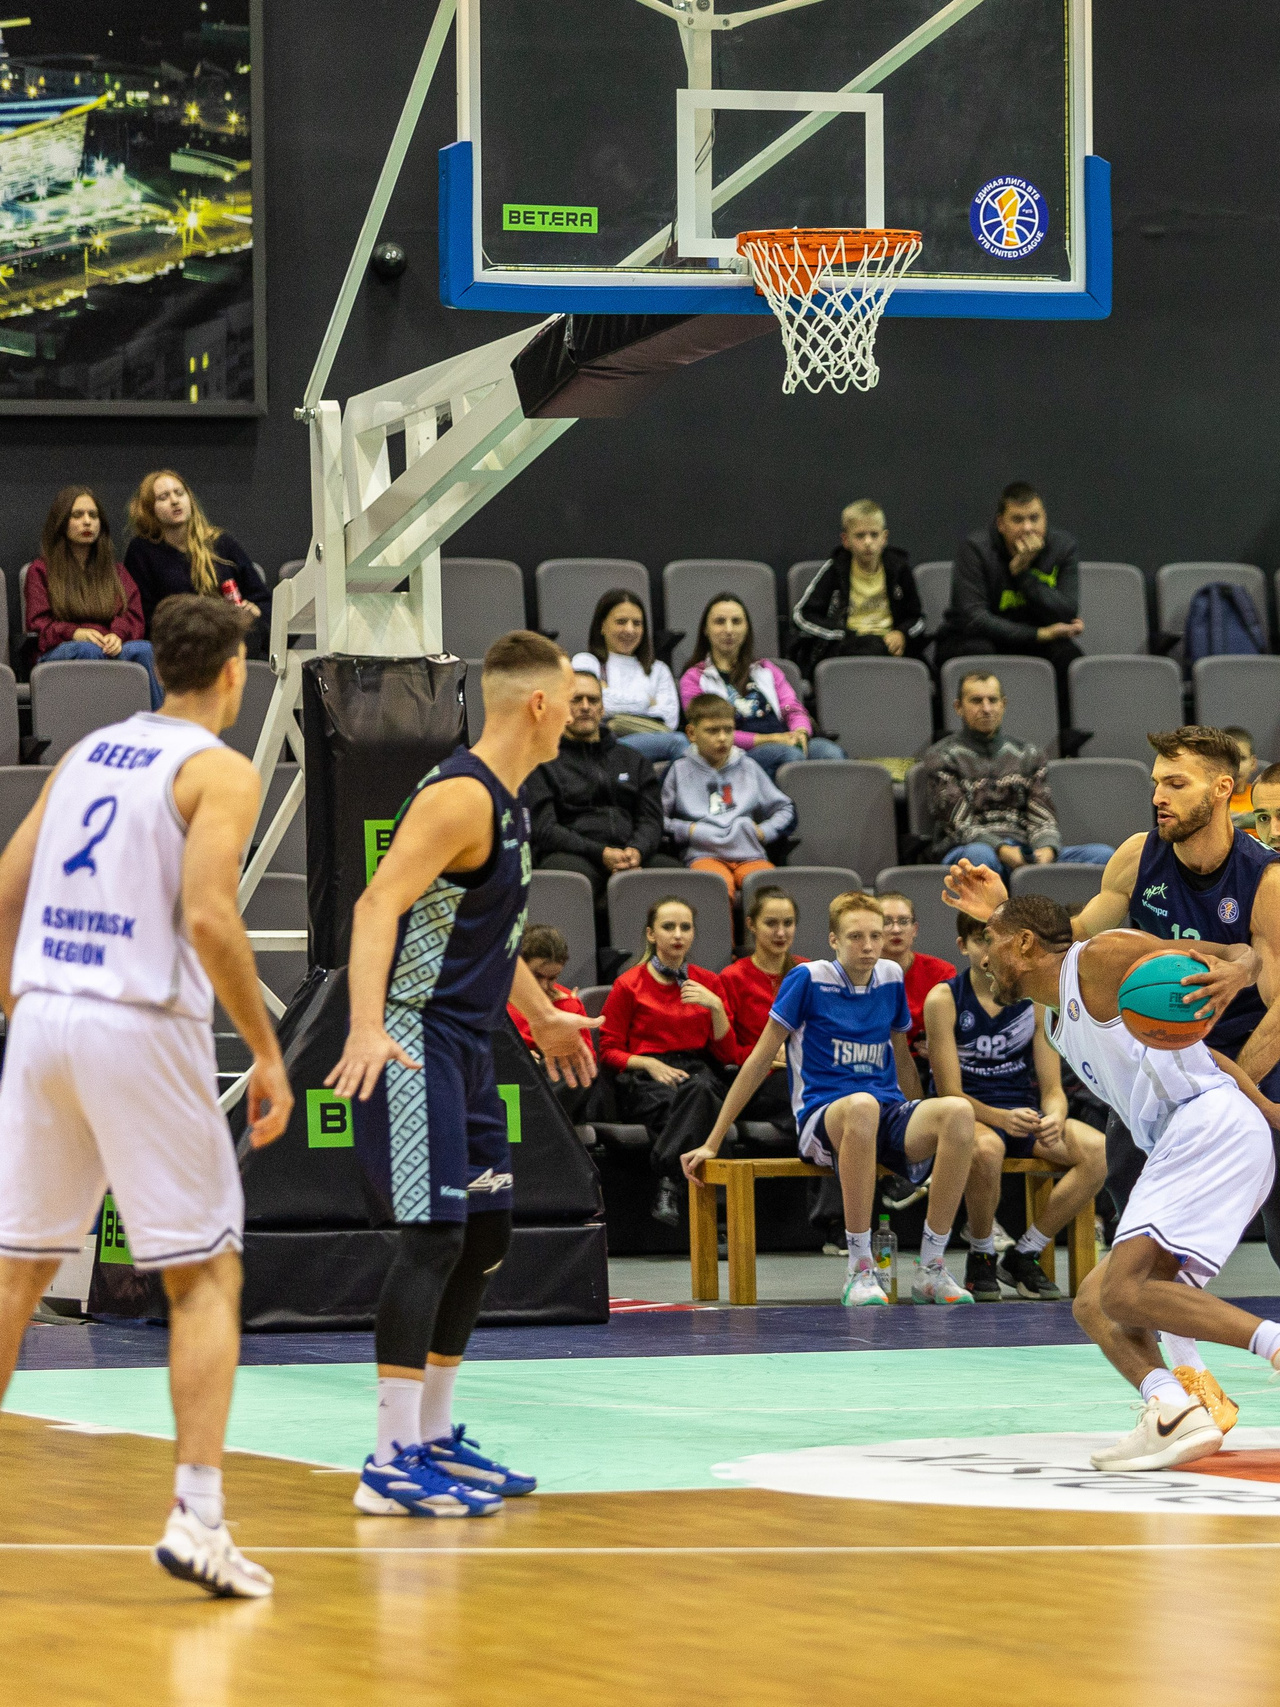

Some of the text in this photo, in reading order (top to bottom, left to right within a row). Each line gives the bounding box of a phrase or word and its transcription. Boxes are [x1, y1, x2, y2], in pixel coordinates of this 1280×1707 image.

[974, 177, 1041, 205] ЕДИНАЯ ЛИГА ВТБ
[977, 230, 1044, 259] VTB UNITED LEAGUE
[63, 795, 118, 876] 2
[1141, 898, 1169, 917] Kempa
[976, 1034, 1008, 1061] 92
